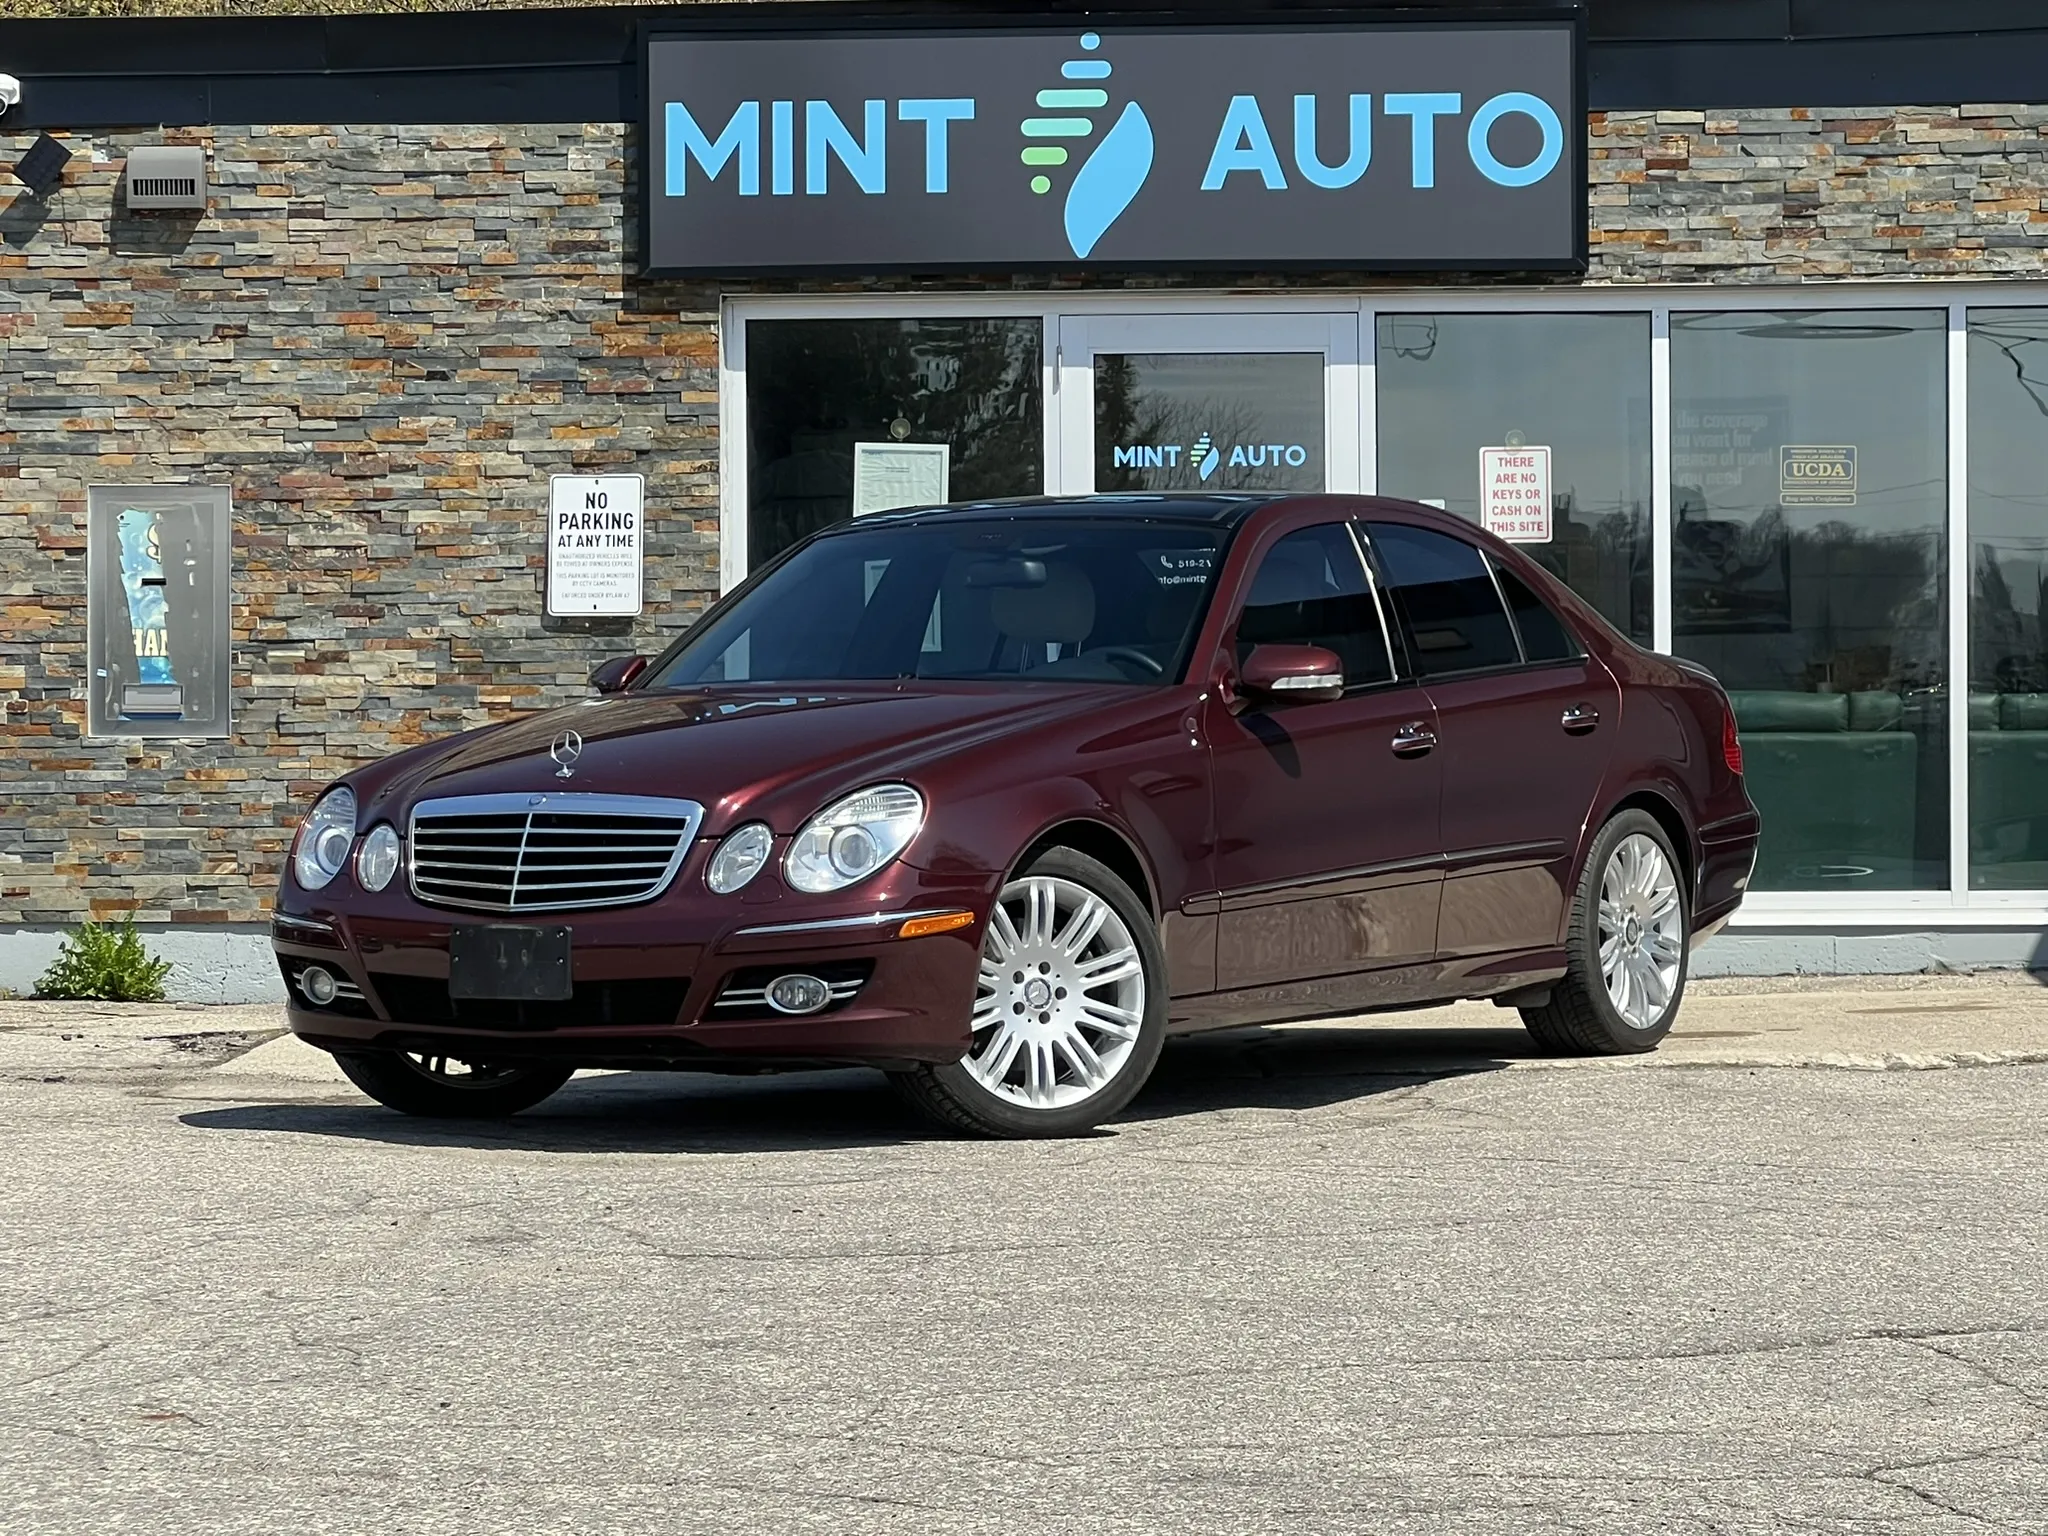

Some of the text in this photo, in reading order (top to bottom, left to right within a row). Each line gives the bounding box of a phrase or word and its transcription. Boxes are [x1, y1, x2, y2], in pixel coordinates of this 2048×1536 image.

[665, 91, 1564, 197] MINT AUTO
[1113, 445, 1306, 467] MINT AUTO
[1497, 457, 1534, 467] THERE
[1792, 463, 1846, 476] UCDA
[1495, 473, 1536, 483] ARE NO
[585, 492, 608, 509] NO
[1492, 489, 1540, 499] KEYS OR
[1492, 505, 1541, 515] CASH ON
[559, 512, 634, 530] PARKING
[1490, 521, 1543, 532] THIS SITE
[558, 534, 634, 548] AT ANY TIME
